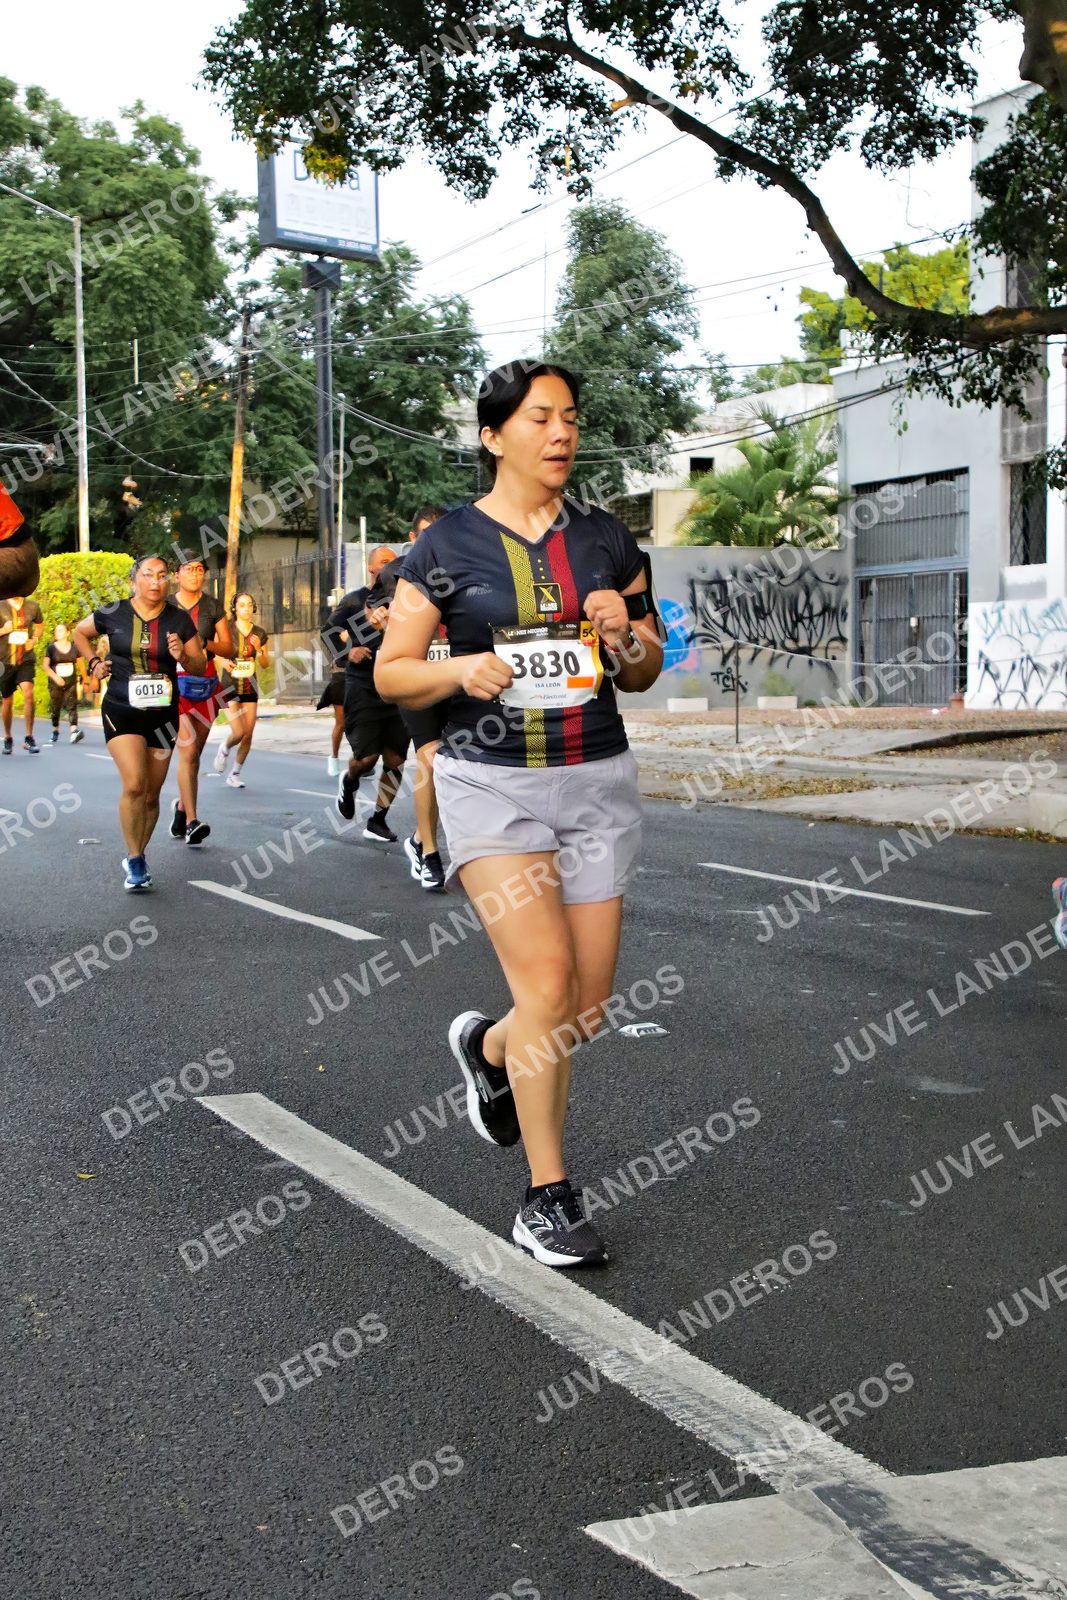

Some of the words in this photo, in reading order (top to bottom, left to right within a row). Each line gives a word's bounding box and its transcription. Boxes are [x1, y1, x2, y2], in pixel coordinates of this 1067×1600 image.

[582, 628, 595, 638] 5K
[511, 650, 581, 679] 3830
[135, 683, 163, 696] 6018
